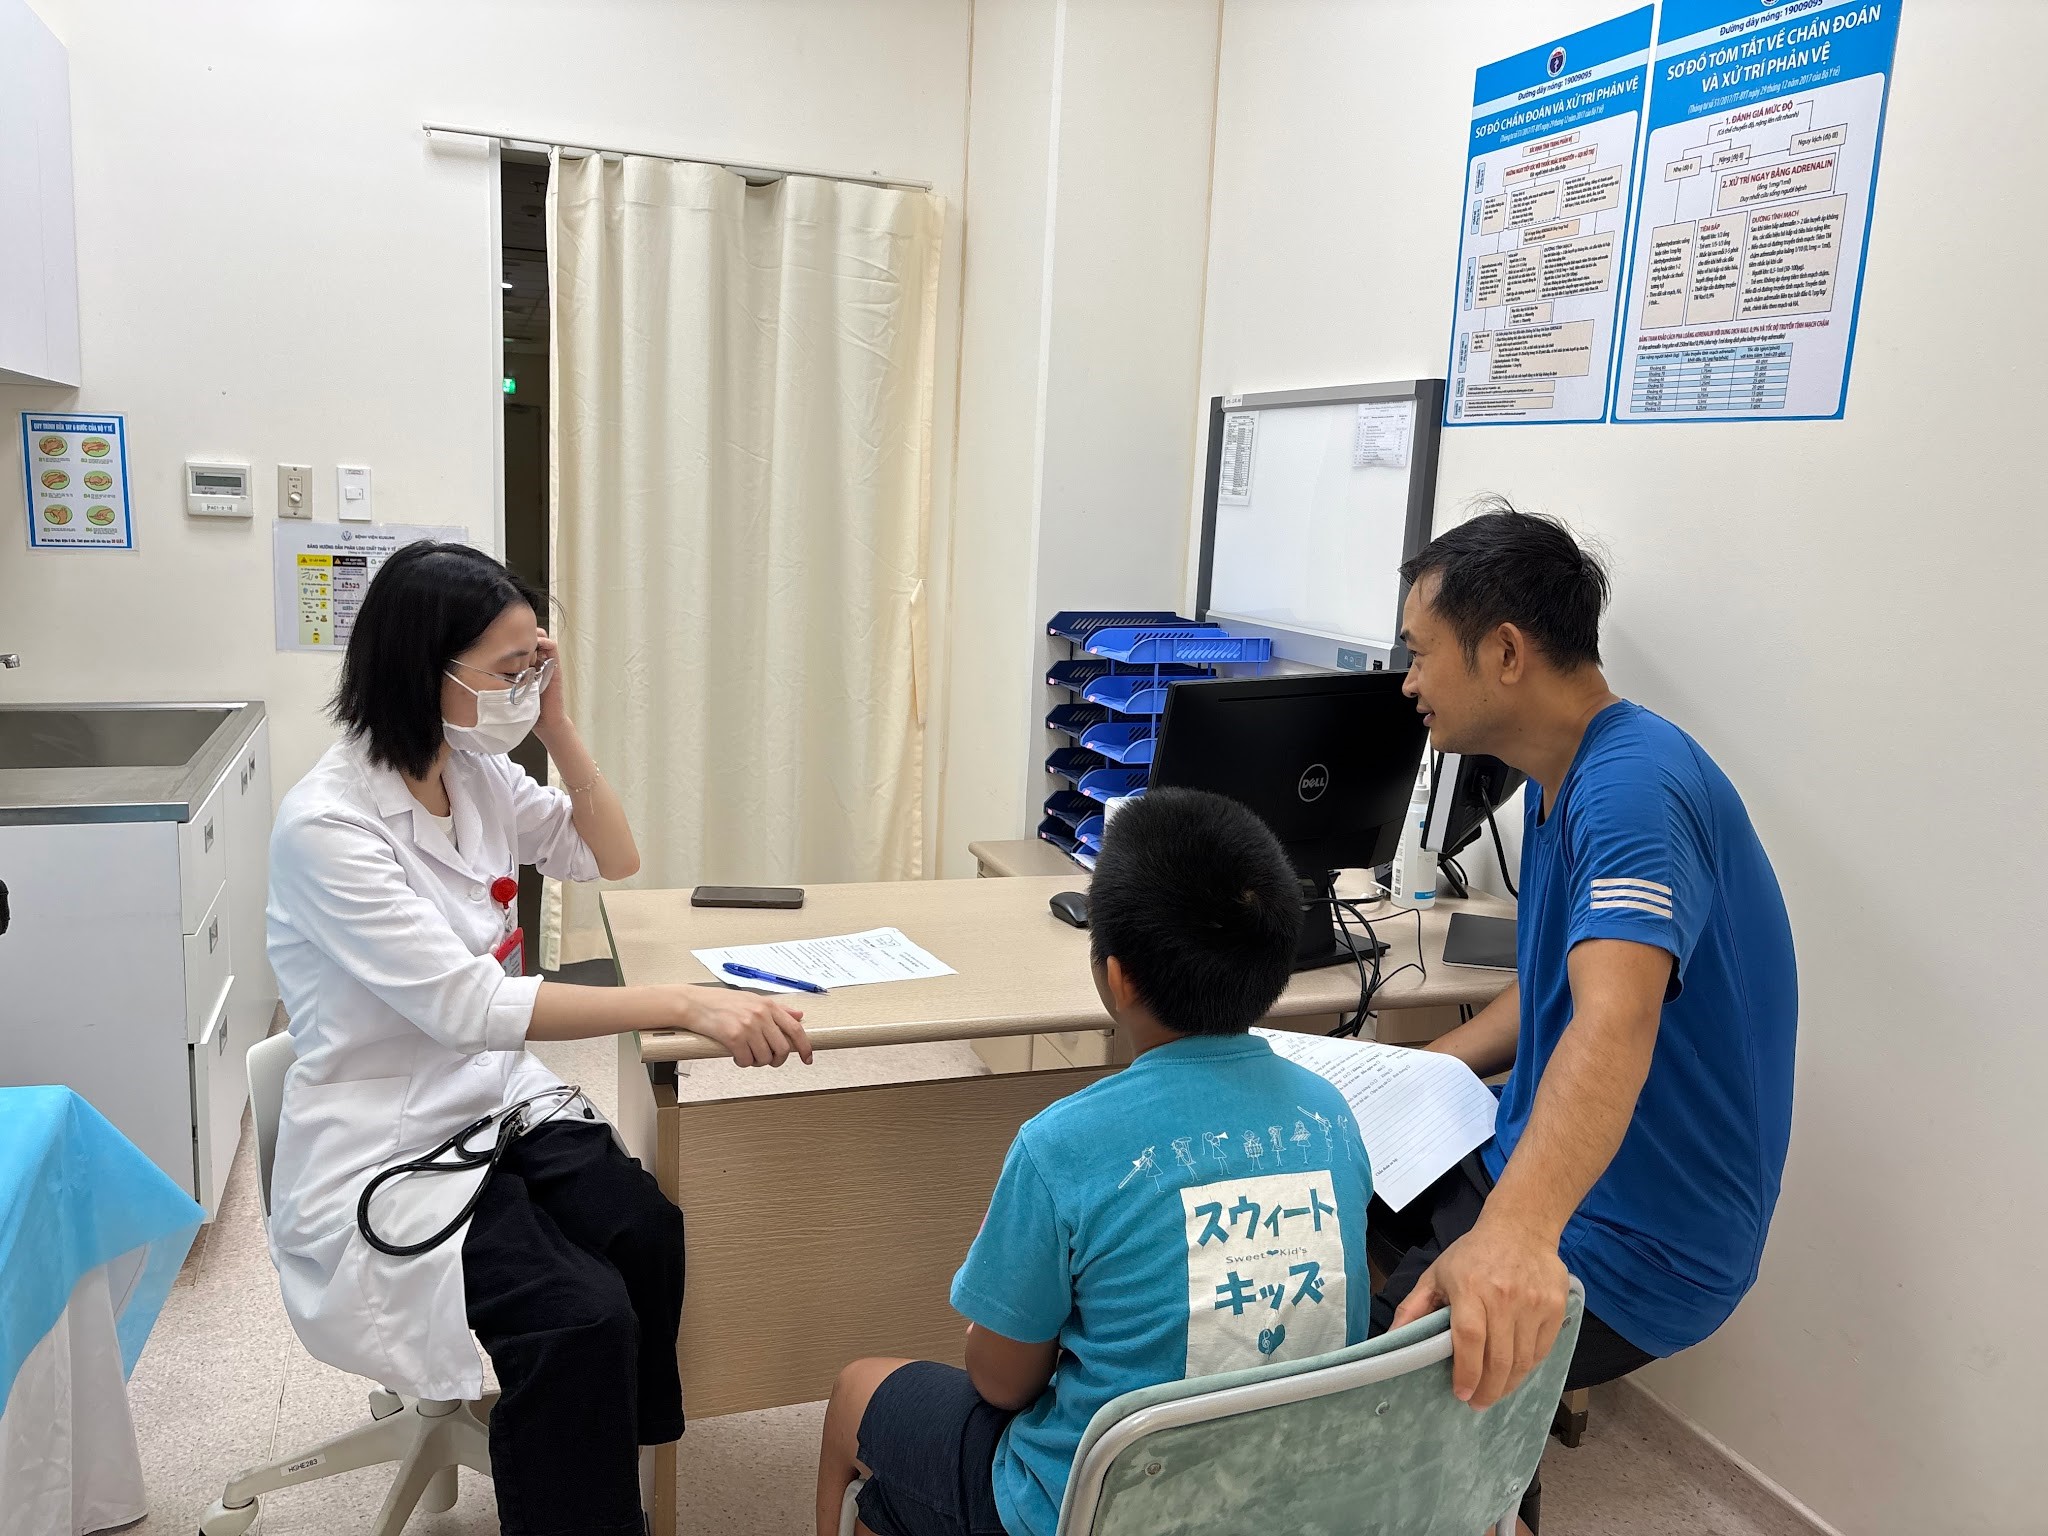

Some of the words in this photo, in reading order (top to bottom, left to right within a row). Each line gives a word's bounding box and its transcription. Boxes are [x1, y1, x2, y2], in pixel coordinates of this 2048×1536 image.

[1720, 22, 1744, 36] Đường
[1746, 17, 1760, 28] dây
[1760, 11, 1783, 23] nóng:
[1667, 60, 1686, 80] SƠ
[1709, 46, 1738, 68] TÓM
[1741, 36, 1765, 58] TẮT
[1767, 27, 1785, 51] VỀ
[1787, 16, 1830, 45] CHẨN
[1833, 4, 1881, 33] ĐOÁN
[1565, 70, 1592, 85] 19009095
[1702, 73, 1719, 93] VÀ
[1721, 64, 1742, 88] XỬ
[1744, 58, 1766, 81] TRÍ
[1767, 48, 1809, 75] PHẢN
[1812, 41, 1830, 65] VỆ
[1475, 124, 1487, 138] SƠ
[1526, 105, 1551, 122] ĐOÁN
[1553, 99, 1564, 114] VÀ
[1566, 93, 1580, 111] XỬ
[1581, 88, 1596, 105] TRÍ
[1596, 81, 1624, 101] PHẢN
[1626, 75, 1639, 93] VỆ
[1732, 111, 1751, 123] ĐÁNH
[1752, 107, 1764, 118] GIÁ
[1765, 103, 1781, 115] MỨC
[1782, 100, 1793, 112] ĐỘ
[1729, 176, 1740, 187] XỬ
[1740, 174, 1751, 184] TRÍ
[1750, 172, 1770, 182] NGAY
[1771, 167, 1790, 179] BẰNG
[1791, 159, 1833, 174] ADRENALIN
[1302, 777, 1324, 788] DELL
[1194, 1187, 1334, 1248] スウィート
[1226, 1253, 1266, 1264] Sweet
[1280, 1247, 1307, 1256] Kid's
[1214, 1260, 1325, 1316] キッズ
